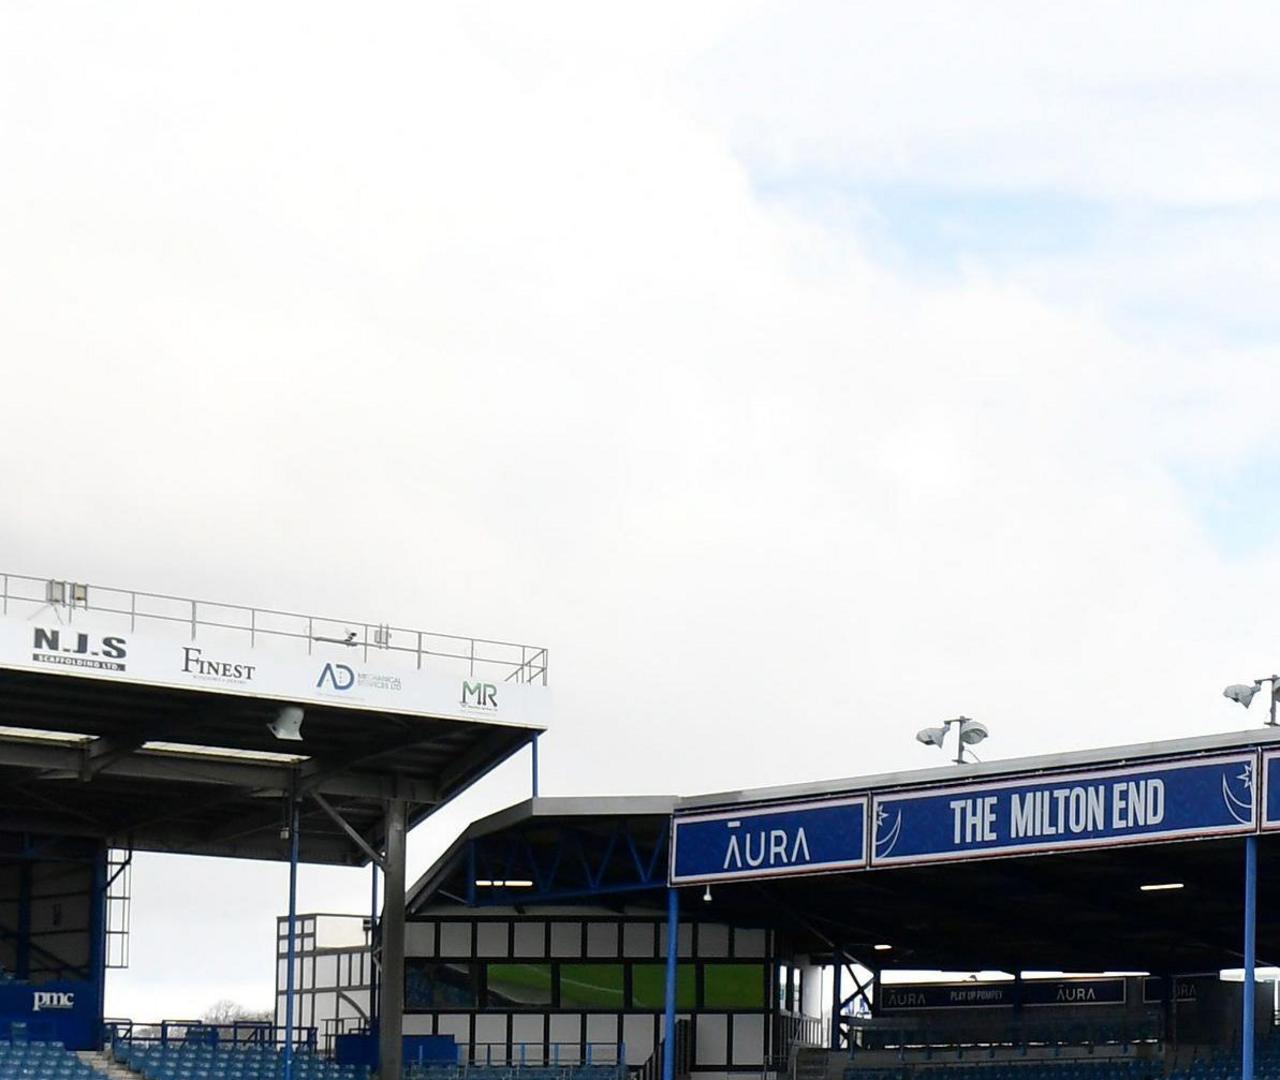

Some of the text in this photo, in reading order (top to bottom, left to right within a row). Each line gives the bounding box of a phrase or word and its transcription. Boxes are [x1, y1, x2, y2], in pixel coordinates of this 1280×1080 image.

[463, 681, 498, 707] MR
[950, 778, 1166, 844] THE MILTON END
[32, 992, 75, 1012] pmc
